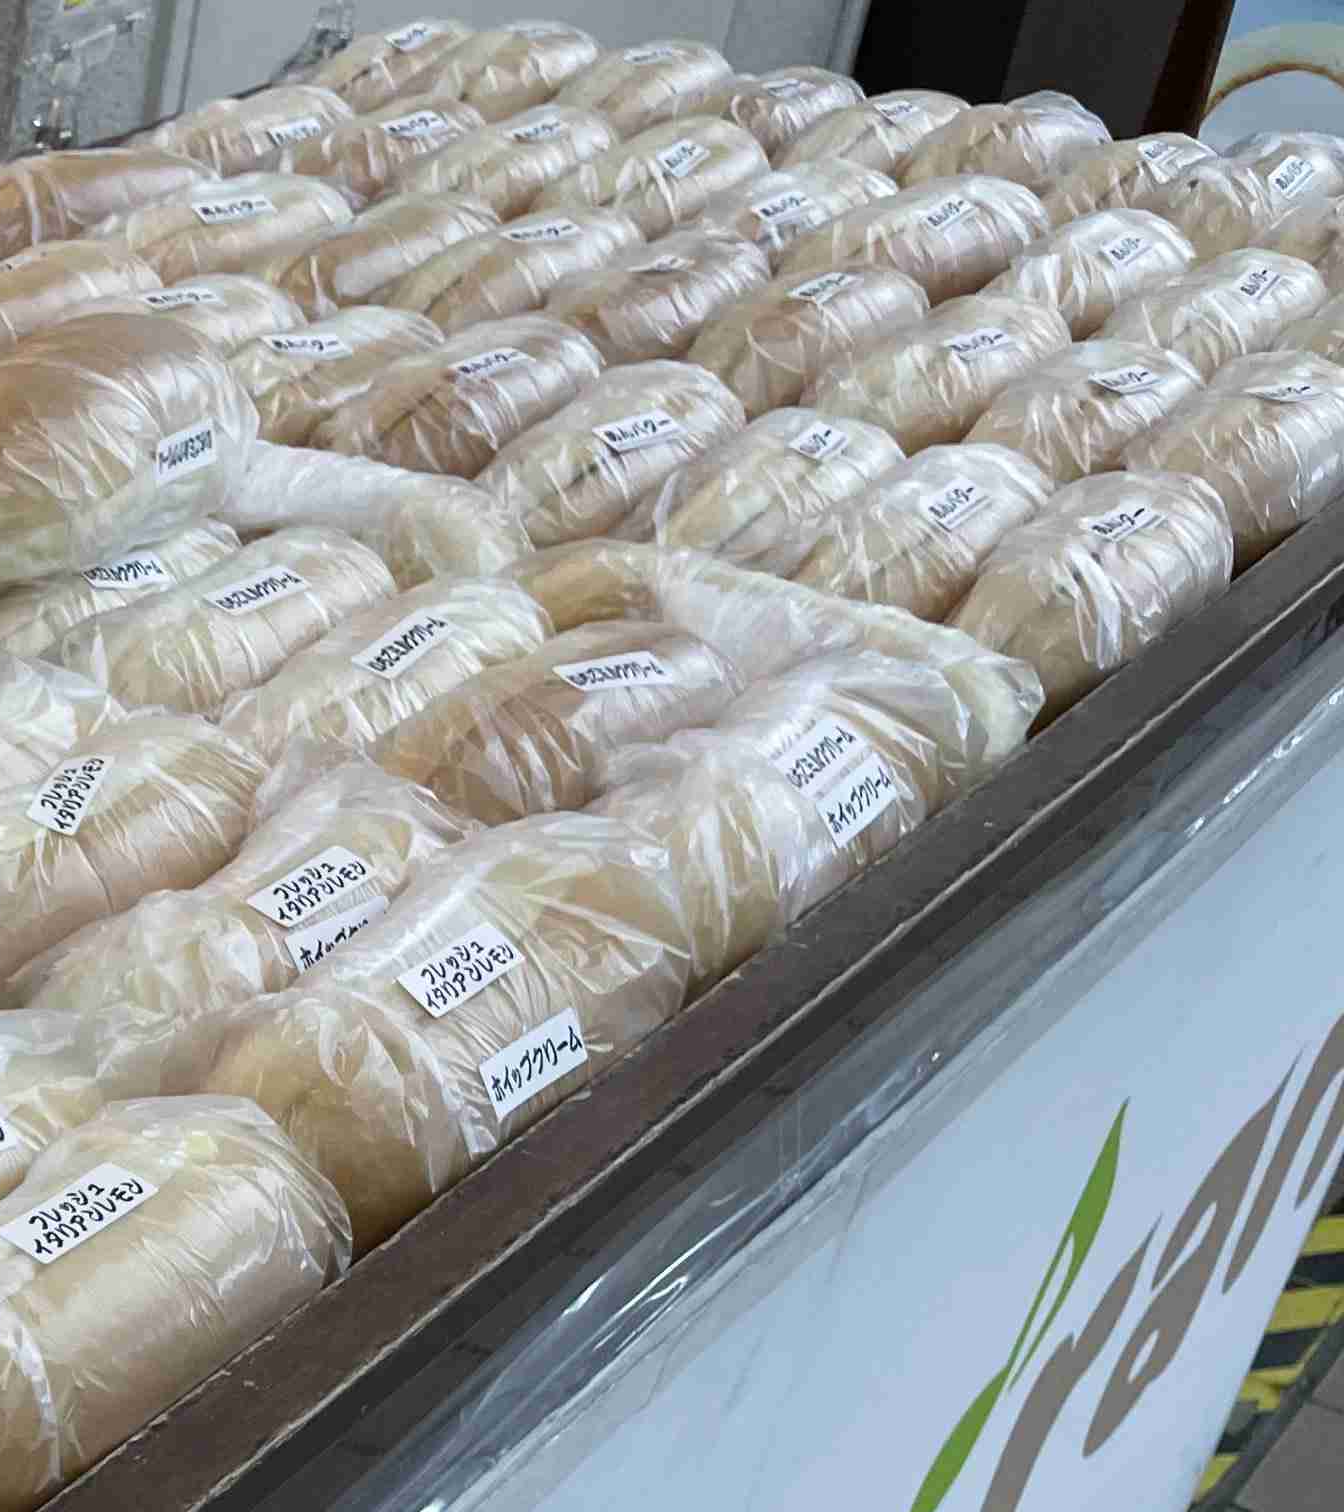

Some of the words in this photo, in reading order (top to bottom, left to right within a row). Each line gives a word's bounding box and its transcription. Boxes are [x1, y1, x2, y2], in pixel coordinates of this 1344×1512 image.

[40, 767, 77, 810] フレッシュ
[52, 757, 105, 830] イタリアンレモン
[273, 862, 335, 900] フレッシュ
[277, 861, 366, 920] イタリアンレモン
[421, 941, 484, 985] フレッシュ
[426, 944, 514, 1010] イタリアンレモン
[491, 1025, 583, 1102] ホイップクリーム
[29, 1183, 105, 1231] フレッシュ
[34, 1178, 145, 1257] イタリアンレモン
